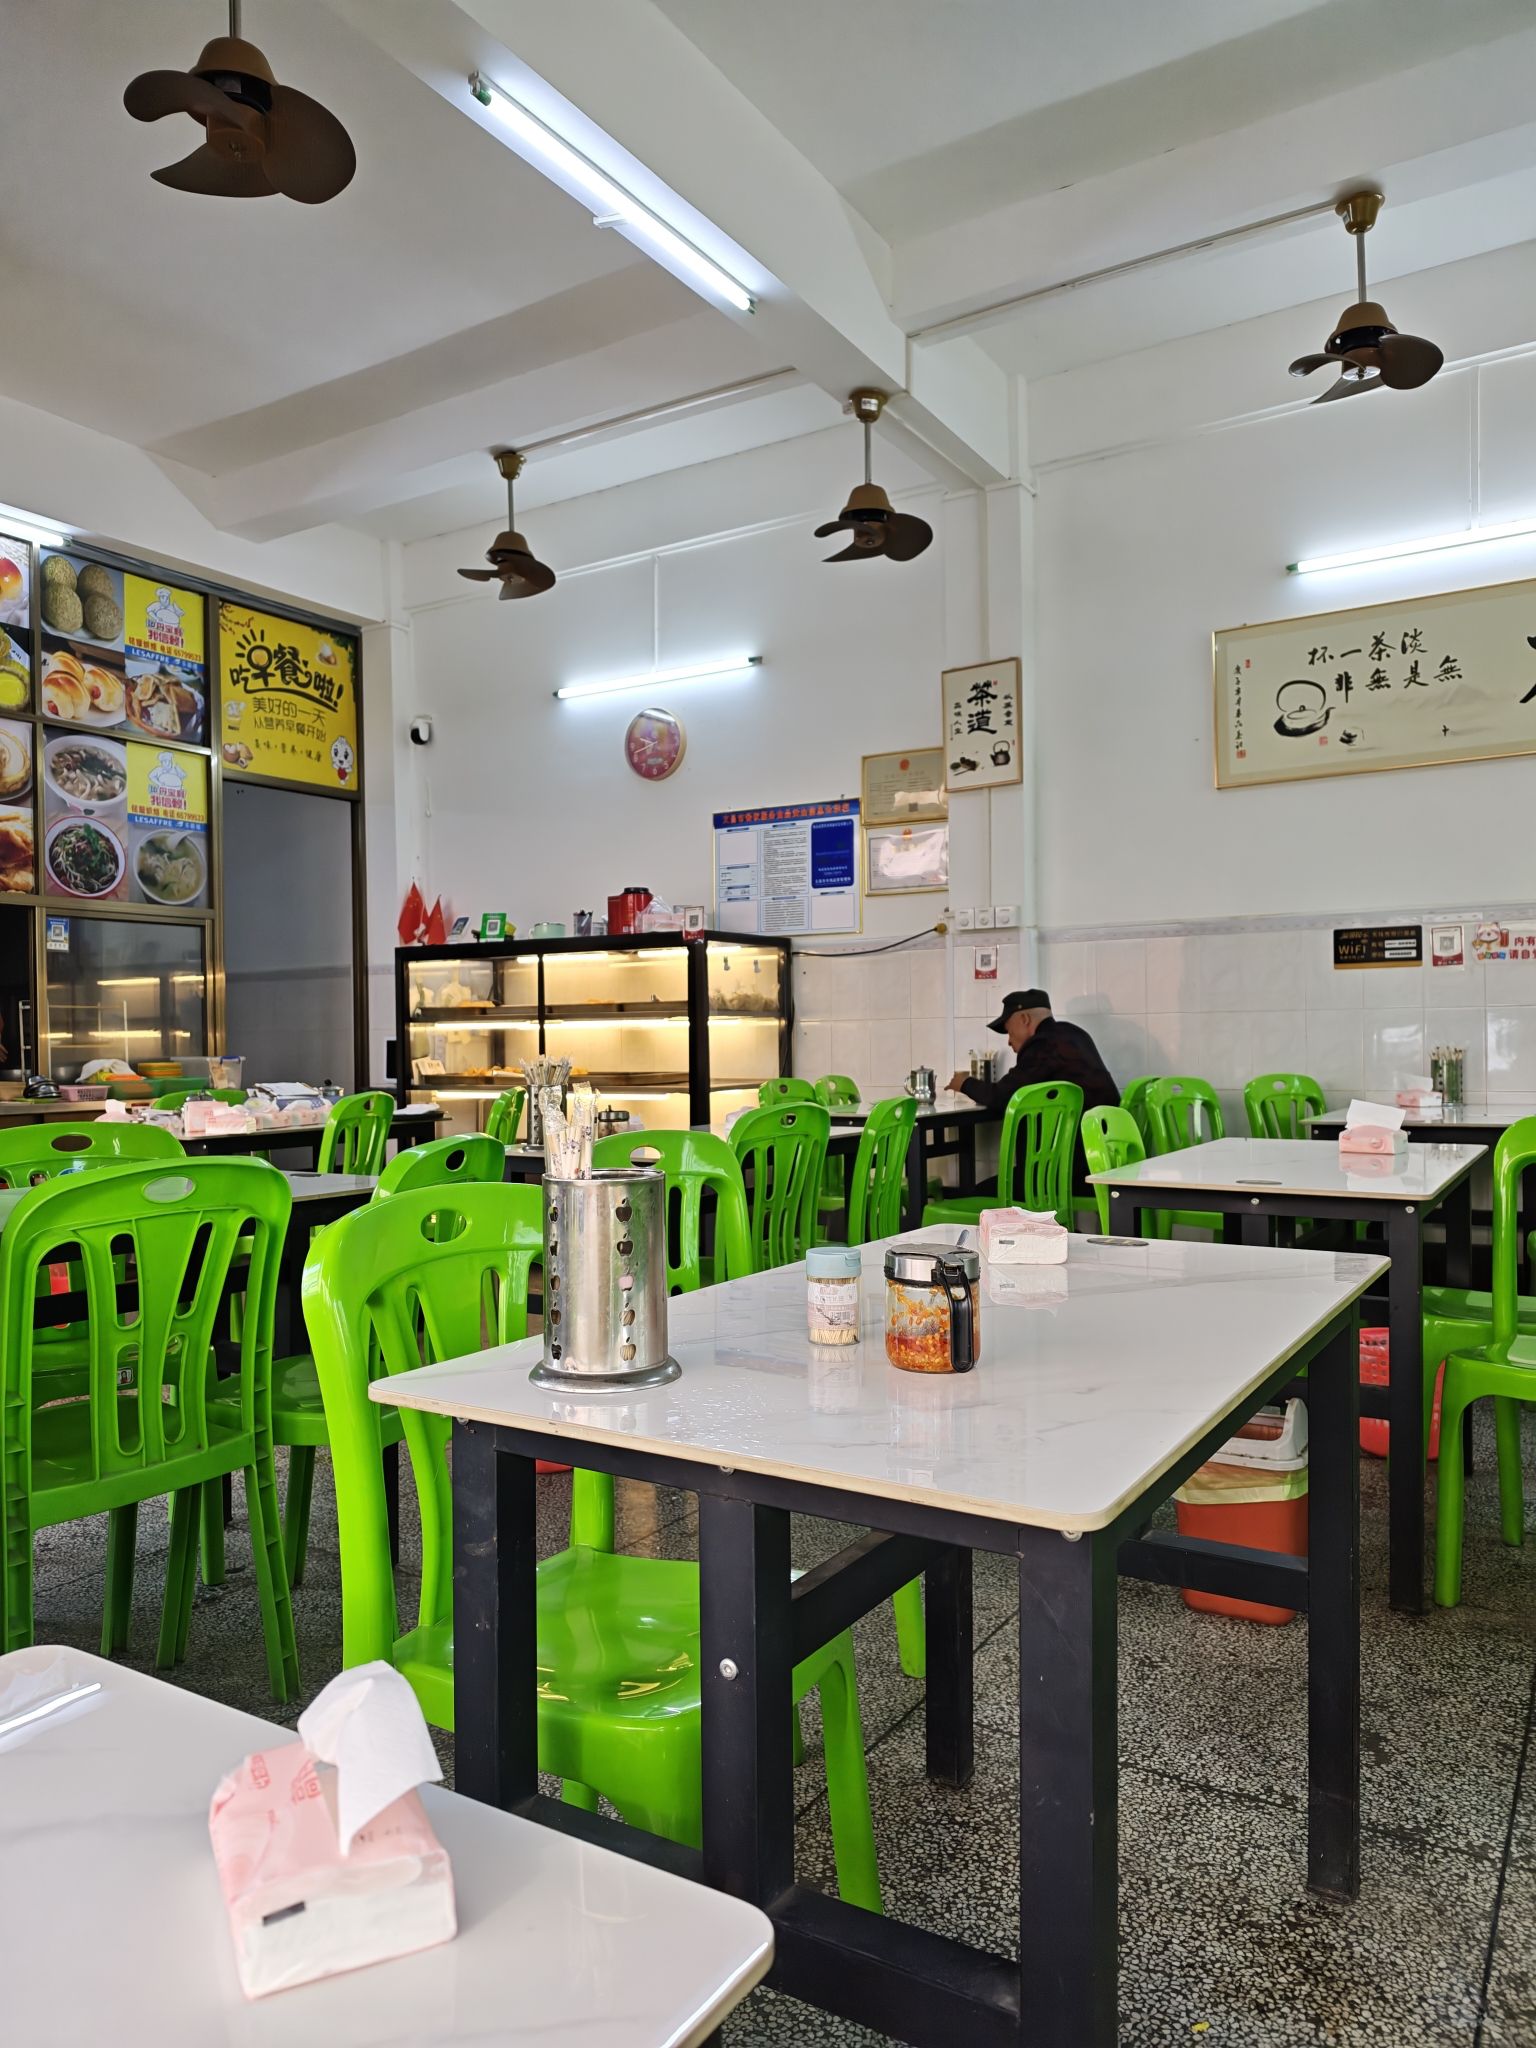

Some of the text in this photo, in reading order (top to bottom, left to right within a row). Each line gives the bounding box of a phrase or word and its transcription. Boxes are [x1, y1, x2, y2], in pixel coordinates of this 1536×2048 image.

[131, 647, 170, 665] LESAFFRE
[252, 696, 327, 728] 美好的一天
[966, 680, 998, 735] 茶道
[254, 716, 327, 742] 从营养早餐开始
[134, 815, 173, 827] LESAFFRE
